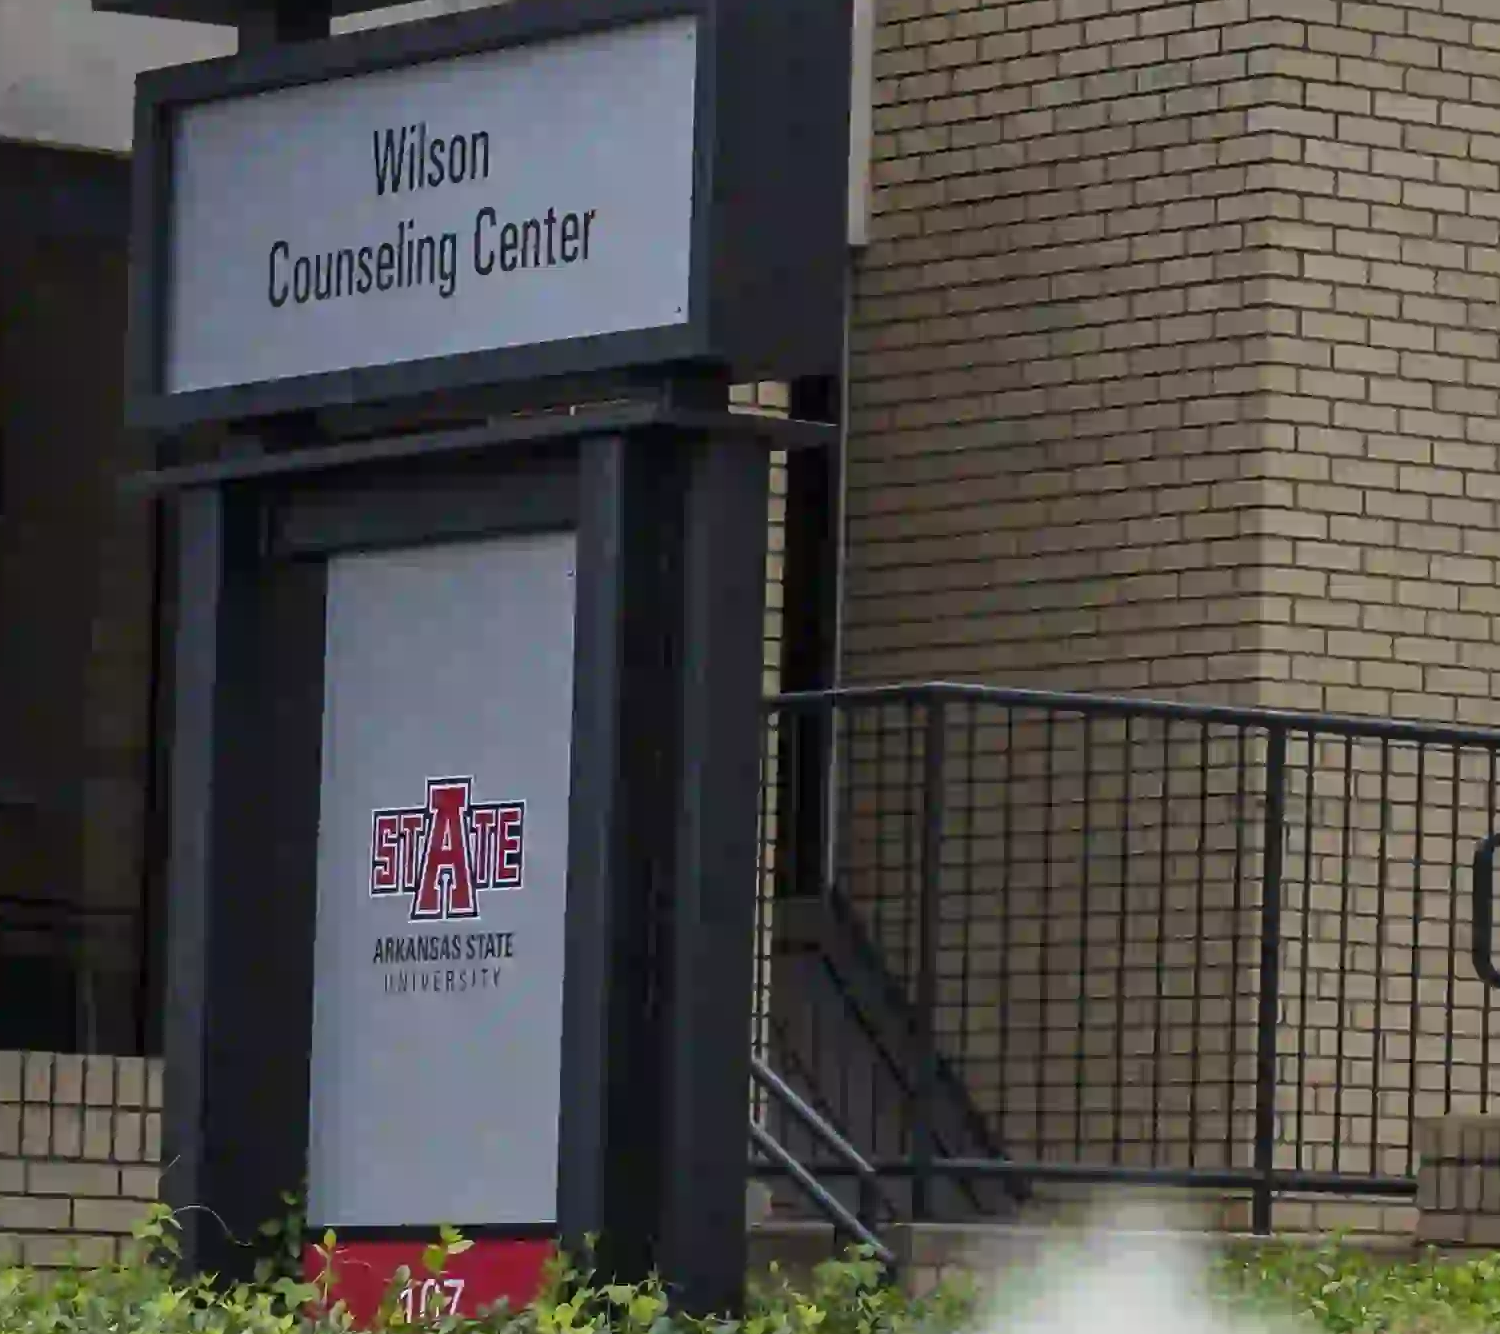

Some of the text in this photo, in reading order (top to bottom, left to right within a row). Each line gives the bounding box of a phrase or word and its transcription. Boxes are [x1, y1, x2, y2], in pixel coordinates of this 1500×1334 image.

[373, 121, 490, 196] Wilson
[268, 206, 597, 308] Counseling Center
[369, 775, 526, 923] STATE
[373, 931, 515, 964] ARKANSAS STATE
[384, 966, 502, 993] UNIVERSITY
